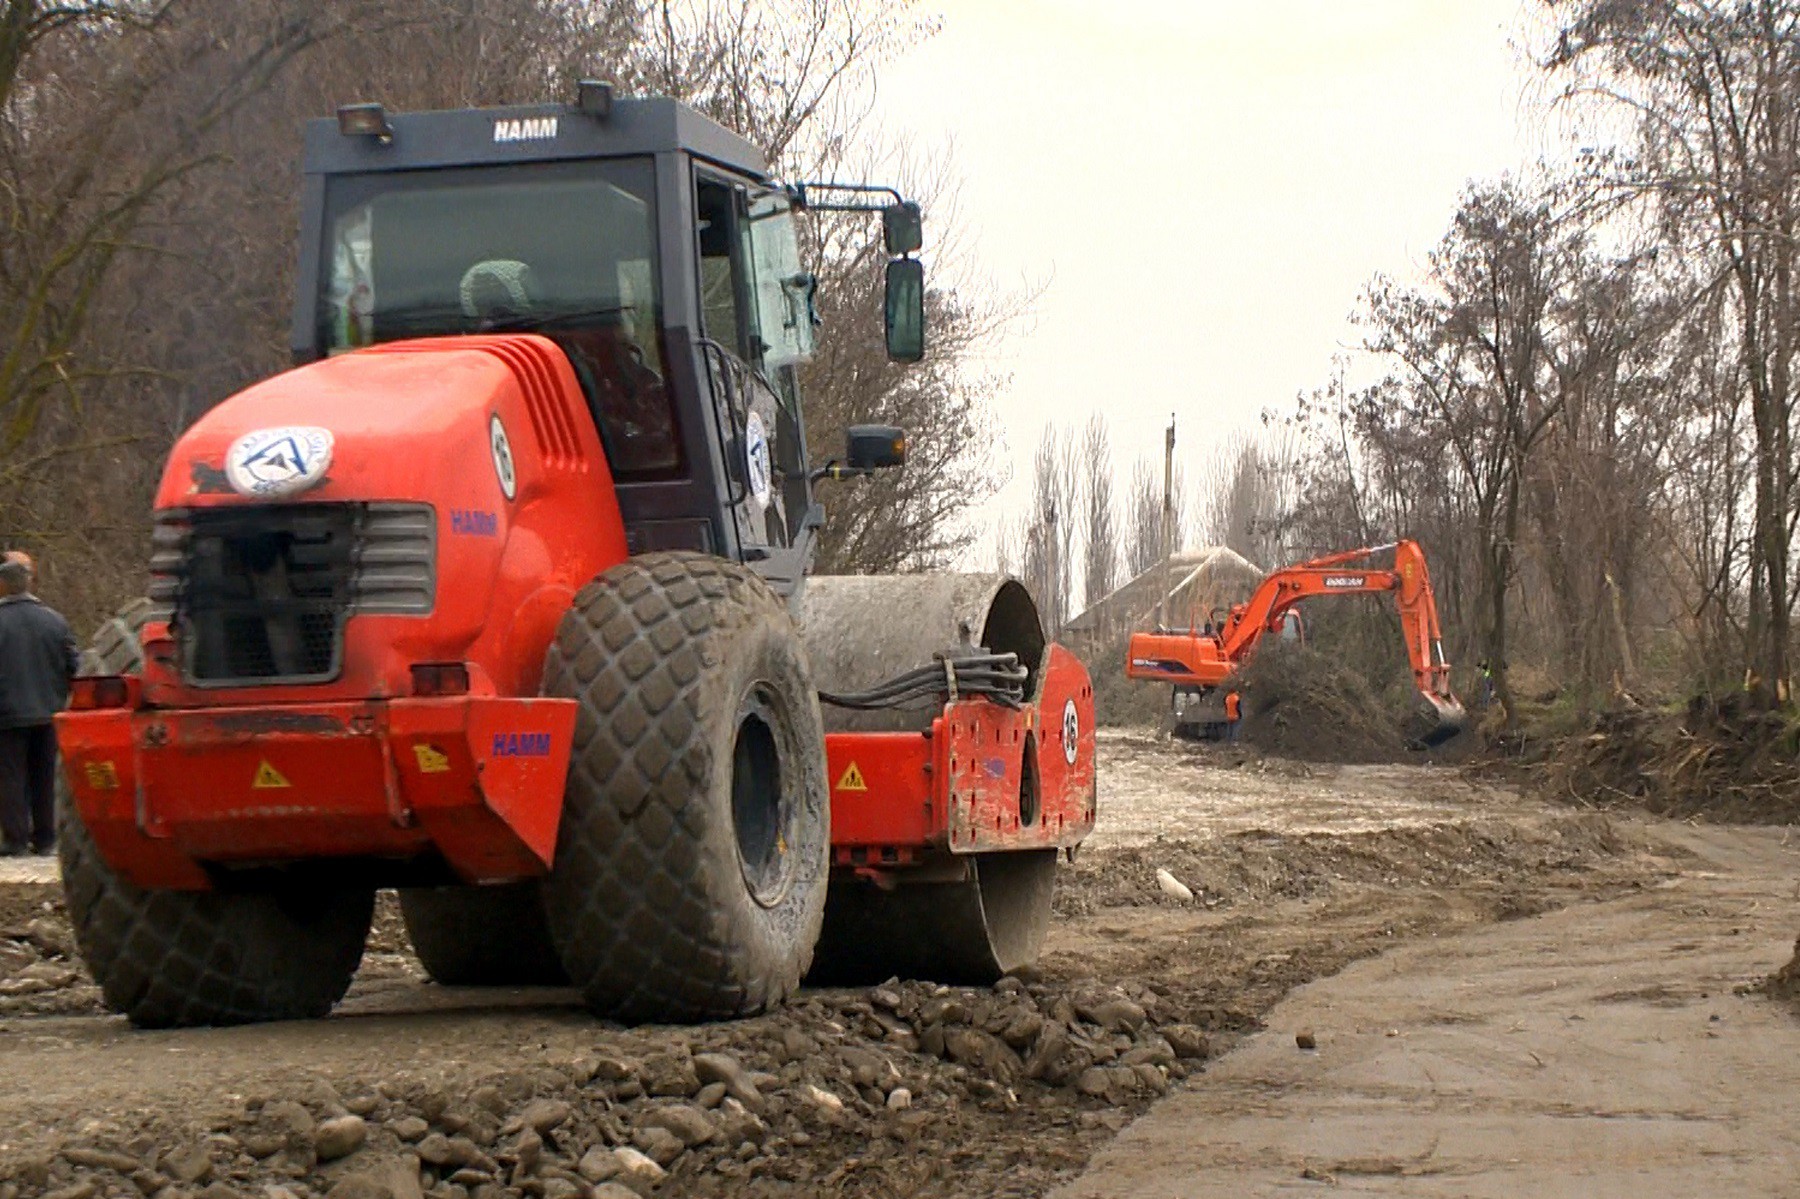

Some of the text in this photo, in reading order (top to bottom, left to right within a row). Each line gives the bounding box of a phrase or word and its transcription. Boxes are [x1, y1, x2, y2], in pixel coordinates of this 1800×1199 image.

[494, 117, 558, 141] HAMM
[450, 509, 497, 536] HAMM
[493, 733, 550, 757] HAMM
